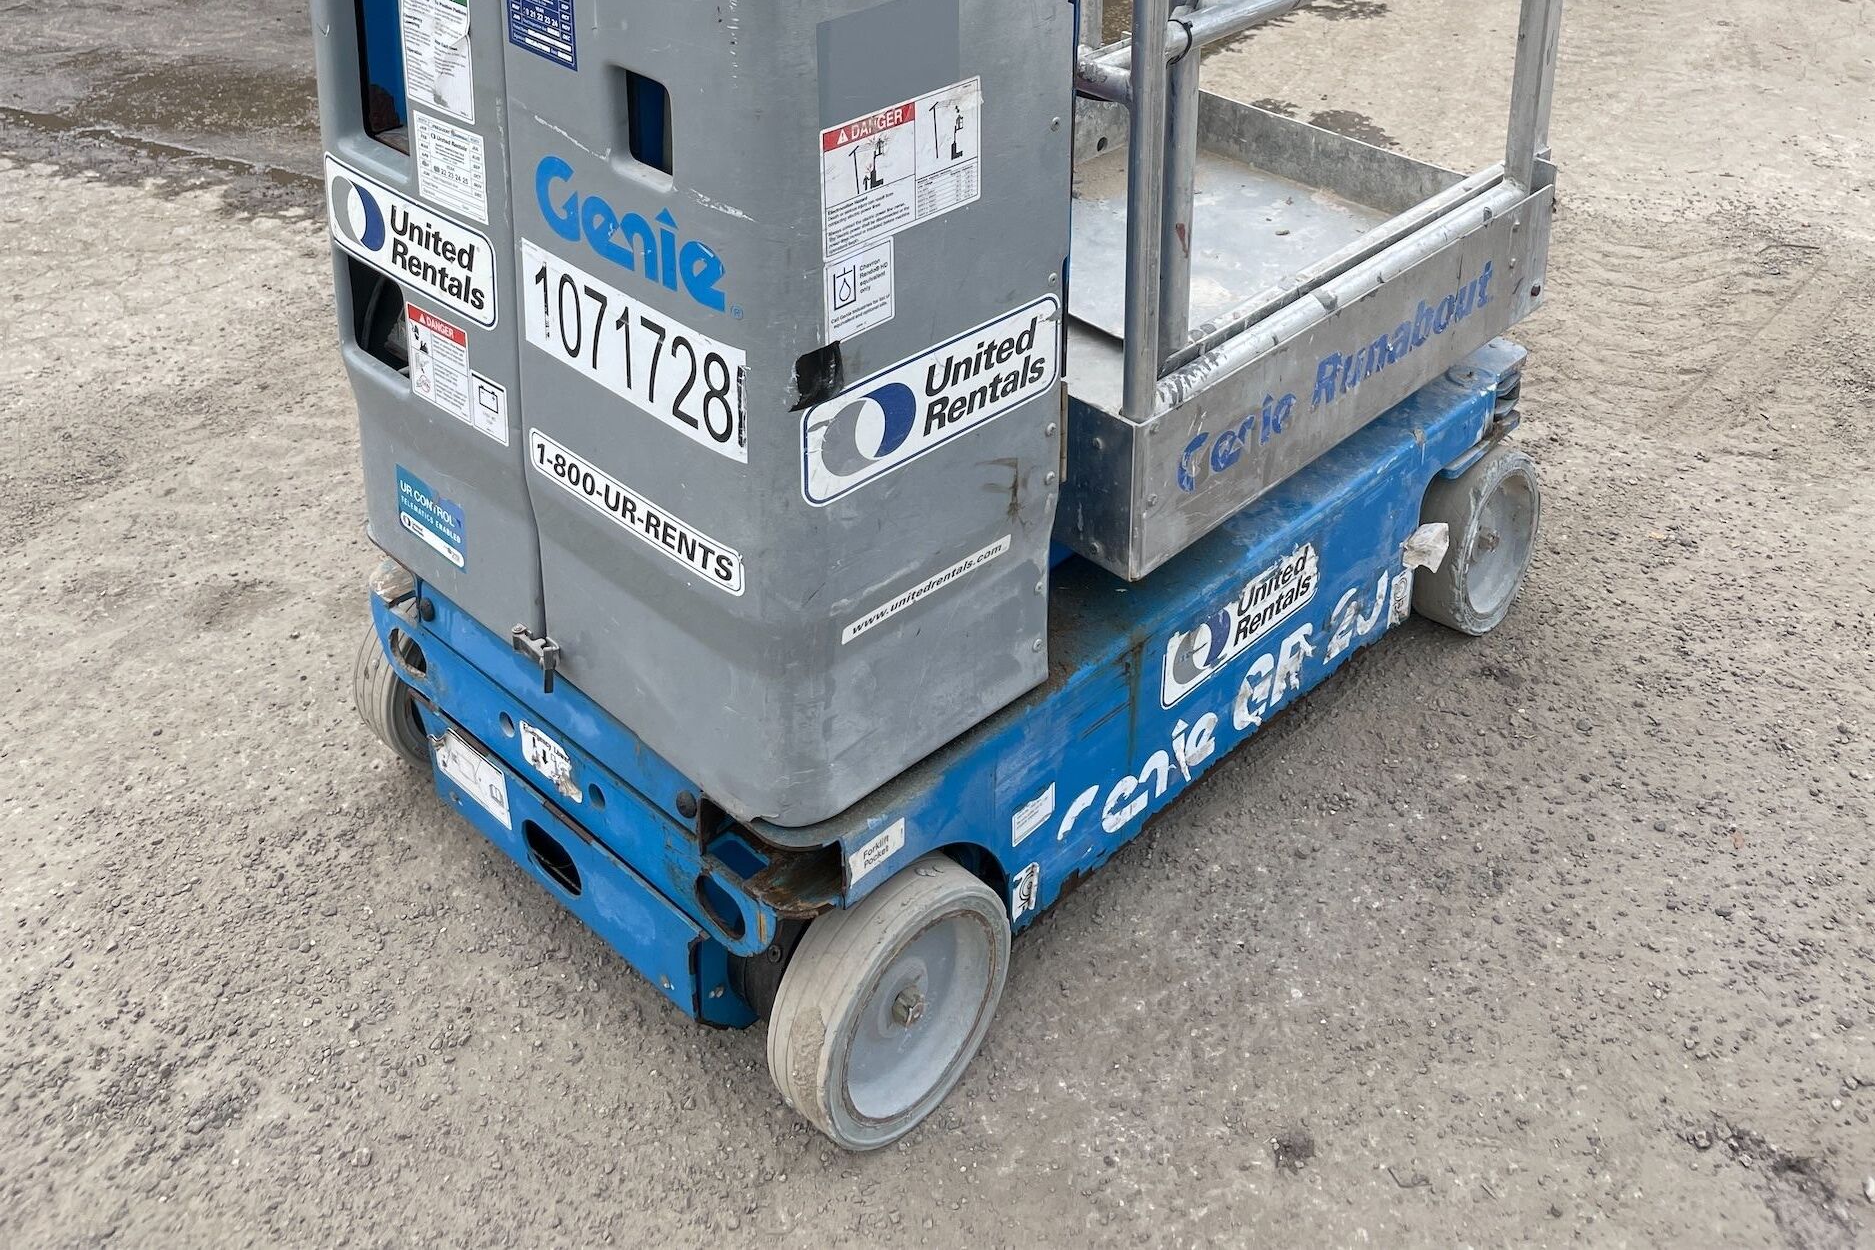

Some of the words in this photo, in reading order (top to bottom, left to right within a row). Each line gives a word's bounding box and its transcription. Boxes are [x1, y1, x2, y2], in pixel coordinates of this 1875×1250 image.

[390, 204, 475, 272] United
[535, 155, 725, 313] Genie
[859, 257, 880, 271] Chevron
[392, 238, 485, 310] Rentals
[427, 316, 454, 338] DANGER
[924, 316, 1037, 398] United
[1312, 260, 1494, 412] Runabout
[923, 354, 1046, 437] Rentals
[400, 479, 413, 497] UR
[401, 495, 434, 524] TELEMATICS
[435, 521, 461, 544] ENABLED
[537, 443, 733, 582] 1-800-UR-RENTS
[852, 544, 1002, 634] www.unitedrentals.com
[1234, 573, 1311, 647] Rentals
[1237, 543, 1309, 616] United
[863, 834, 889, 859] Forklift
[864, 845, 889, 868] Pocket
